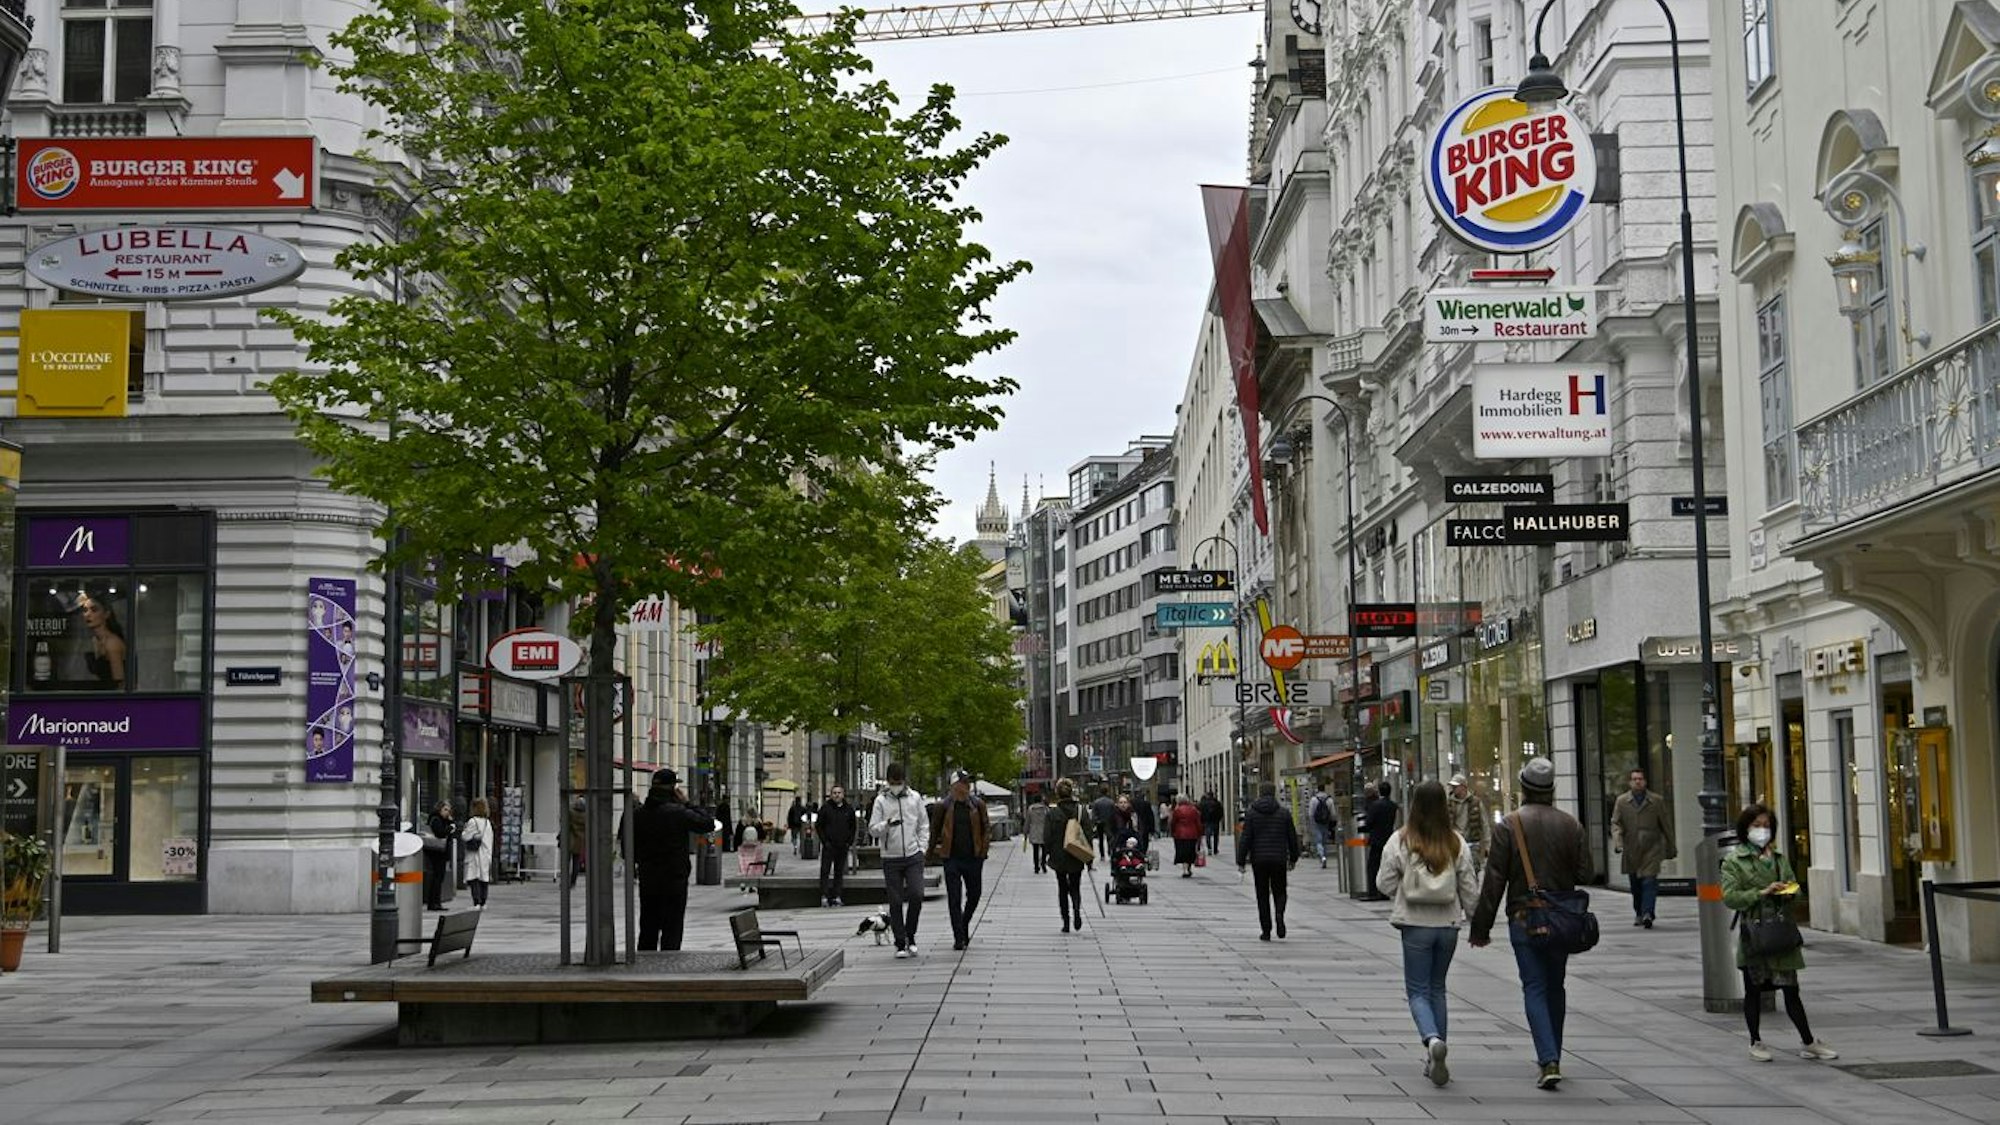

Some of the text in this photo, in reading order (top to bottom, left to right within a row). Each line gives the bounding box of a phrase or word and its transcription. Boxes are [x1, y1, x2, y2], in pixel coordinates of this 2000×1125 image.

[1447, 115, 1568, 176] BURGER
[33, 158, 73, 176] BURGER
[90, 160, 254, 175] BURGER KING
[35, 165, 74, 188] KING
[89, 178, 145, 188] Annagasse
[1455, 142, 1575, 215] KING
[79, 229, 250, 256] LUBELLA
[114, 254, 213, 265] RESTAURANT
[147, 268, 180, 279] 15 M
[69, 277, 132, 294] SCHNITZEL
[178, 283, 210, 293] PIZZA
[220, 276, 256, 289] PASTA
[1436, 297, 1562, 320] Wienerwald
[1440, 322, 1588, 337] 30m Restaurant
[1500, 388, 1562, 404] Hardegg
[1568, 375, 1606, 415] H
[1480, 405, 1562, 417] Immobilien
[1480, 427, 1607, 442] www.verwaltung.at
[1453, 483, 1545, 495] CALZEDONIA
[1513, 515, 1620, 531] HALLHUBER
[59, 525, 94, 559] M
[1159, 573, 1213, 584] METO
[1357, 612, 1406, 625] LLOYD
[517, 645, 553, 660] EMI
[1263, 638, 1305, 657] MF
[18, 713, 129, 739] Marionnaud
[60, 737, 90, 745] PARIS
[164, 846, 196, 857] -30%
